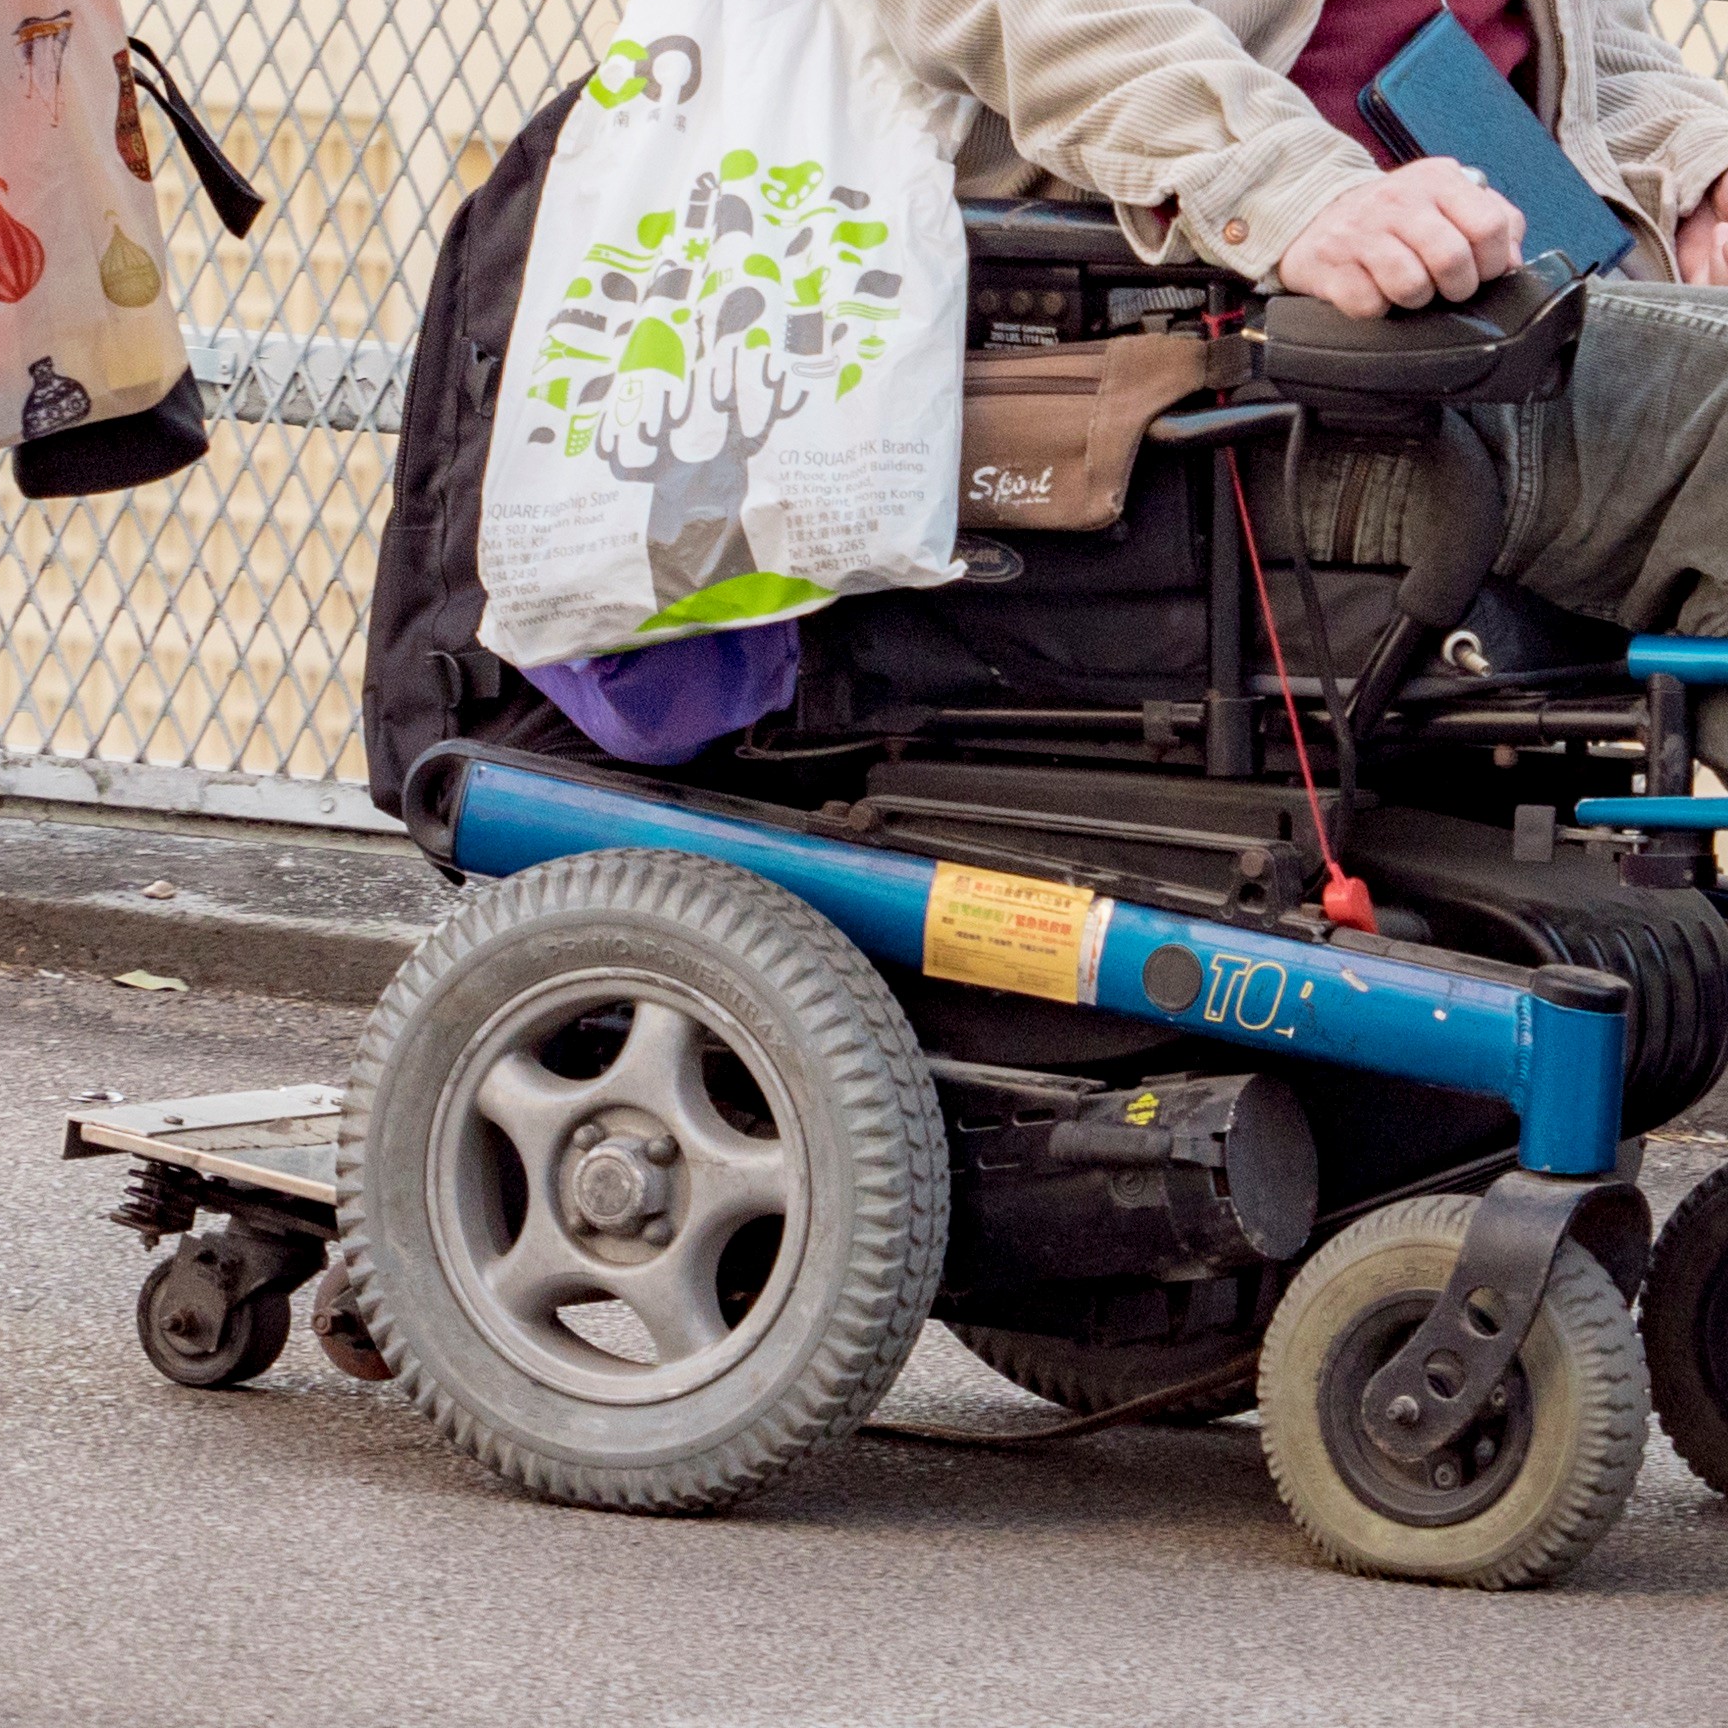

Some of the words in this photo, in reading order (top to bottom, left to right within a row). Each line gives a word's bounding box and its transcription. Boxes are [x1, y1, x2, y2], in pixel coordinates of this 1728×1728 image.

[859, 440, 878, 457] HK
[882, 439, 930, 456] Branch
[590, 490, 620, 507] Store
[890, 488, 925, 501] Kong
[505, 523, 526, 534] 503
[843, 554, 871, 569] 1150
